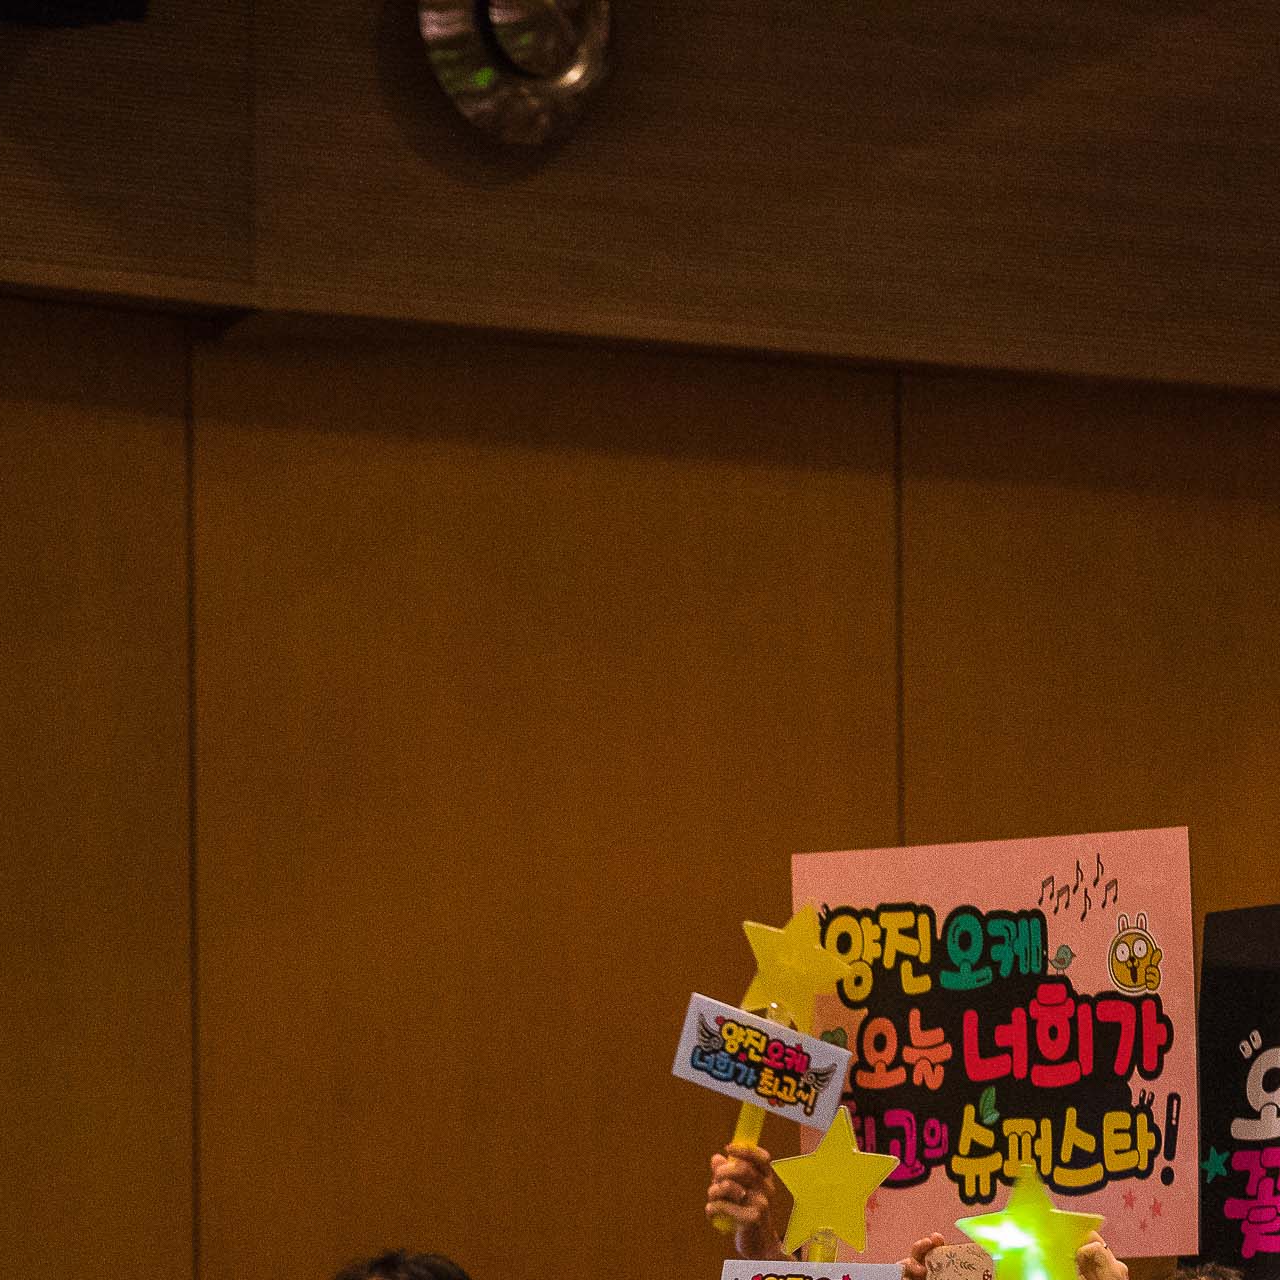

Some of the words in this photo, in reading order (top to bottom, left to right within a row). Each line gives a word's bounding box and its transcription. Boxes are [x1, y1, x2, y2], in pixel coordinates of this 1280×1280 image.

[939, 910, 1044, 990] 오케
[691, 1047, 757, 1088] 너희가
[721, 1021, 767, 1063] 양진
[762, 1041, 810, 1073] 오케
[854, 1008, 953, 1091] 오늘
[962, 982, 1169, 1090] 너희가
[950, 1092, 1184, 1198] 슈퍼스타!
